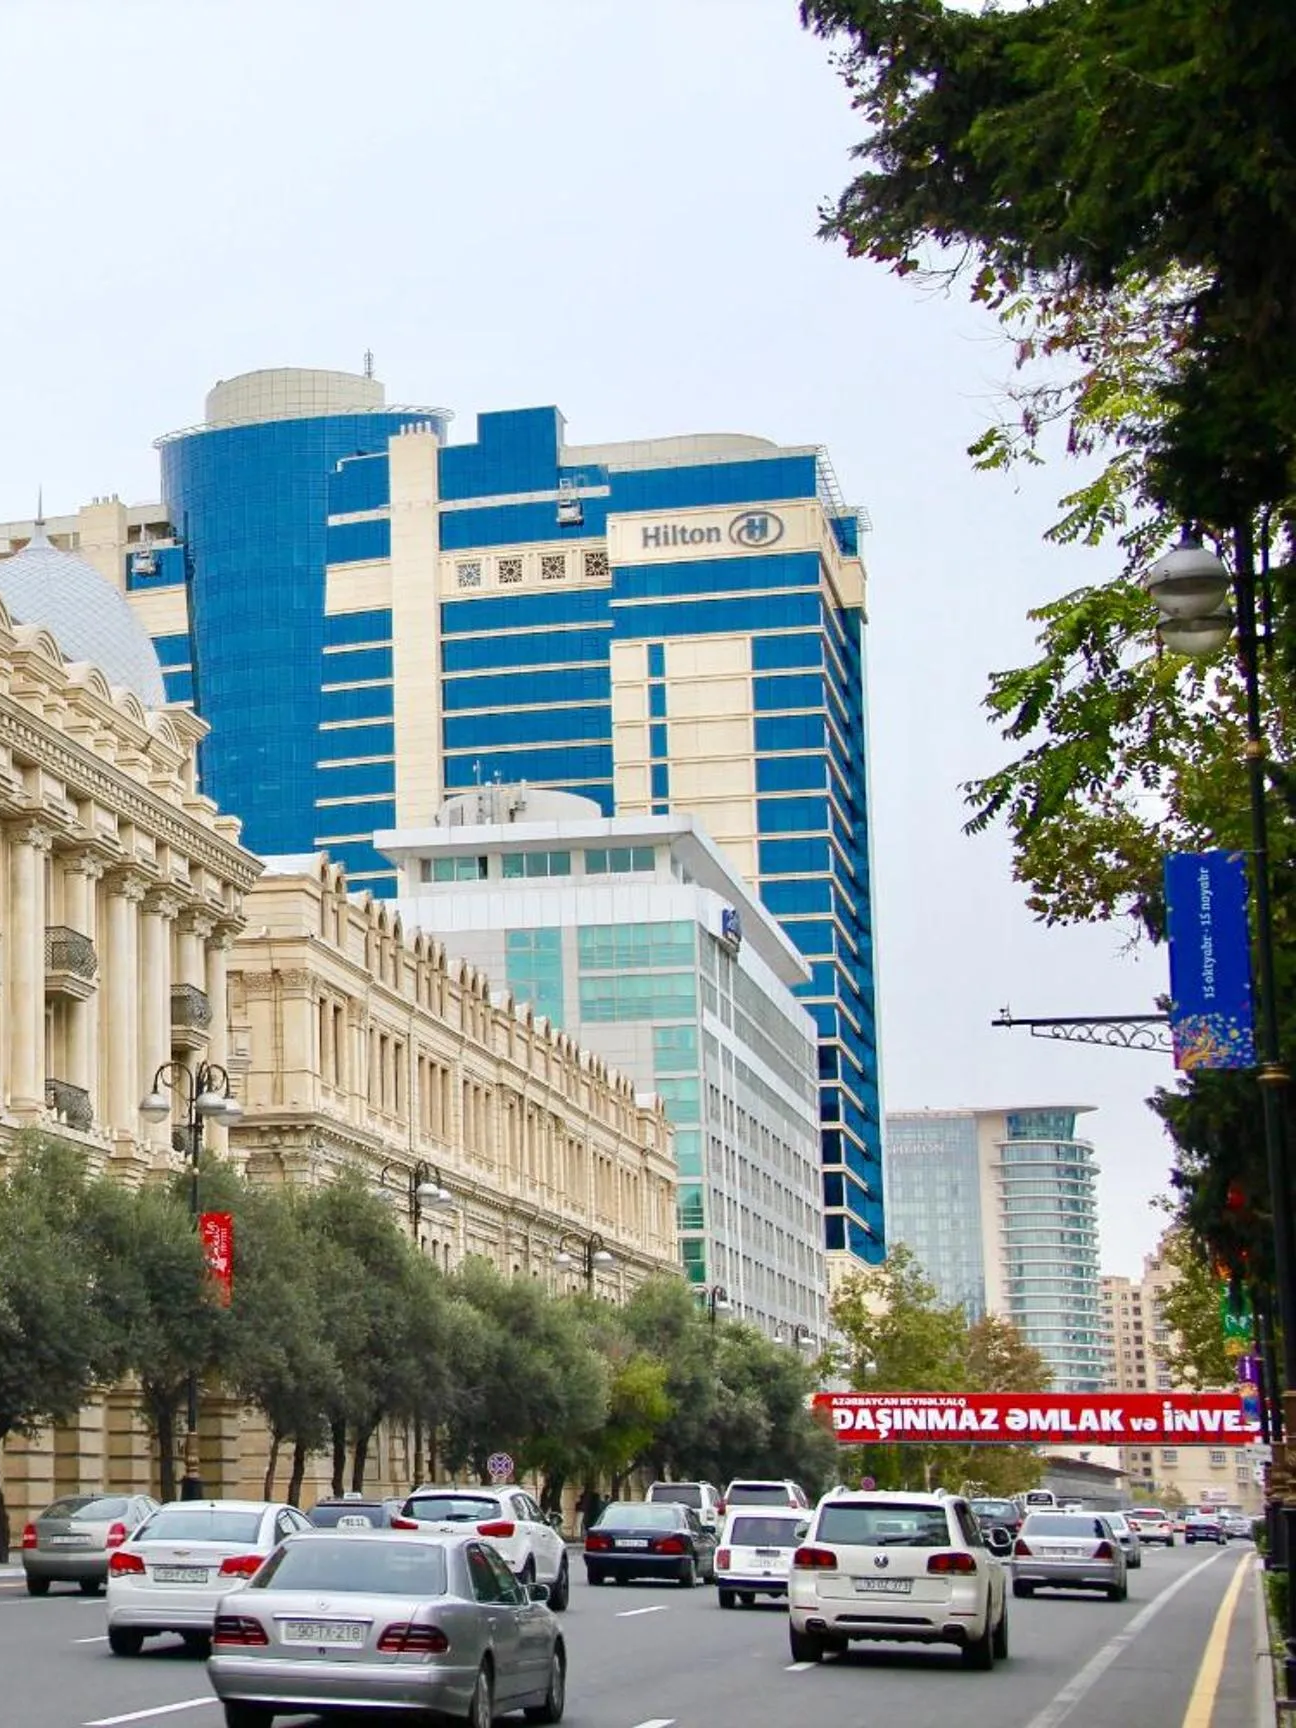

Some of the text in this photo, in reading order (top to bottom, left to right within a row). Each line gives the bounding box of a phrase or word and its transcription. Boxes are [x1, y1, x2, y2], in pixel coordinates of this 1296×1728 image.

[642, 524, 721, 548] Hilton
[1197, 867, 1214, 911] noyabr
[1199, 913, 1211, 926] 15
[1200, 936, 1216, 984] oktyabr
[1203, 986, 1215, 999] 15
[832, 1408, 1000, 1439] DAŞINMAZ
[1005, 1408, 1125, 1431] ƏMLAK
[1130, 1417, 1158, 1431] və
